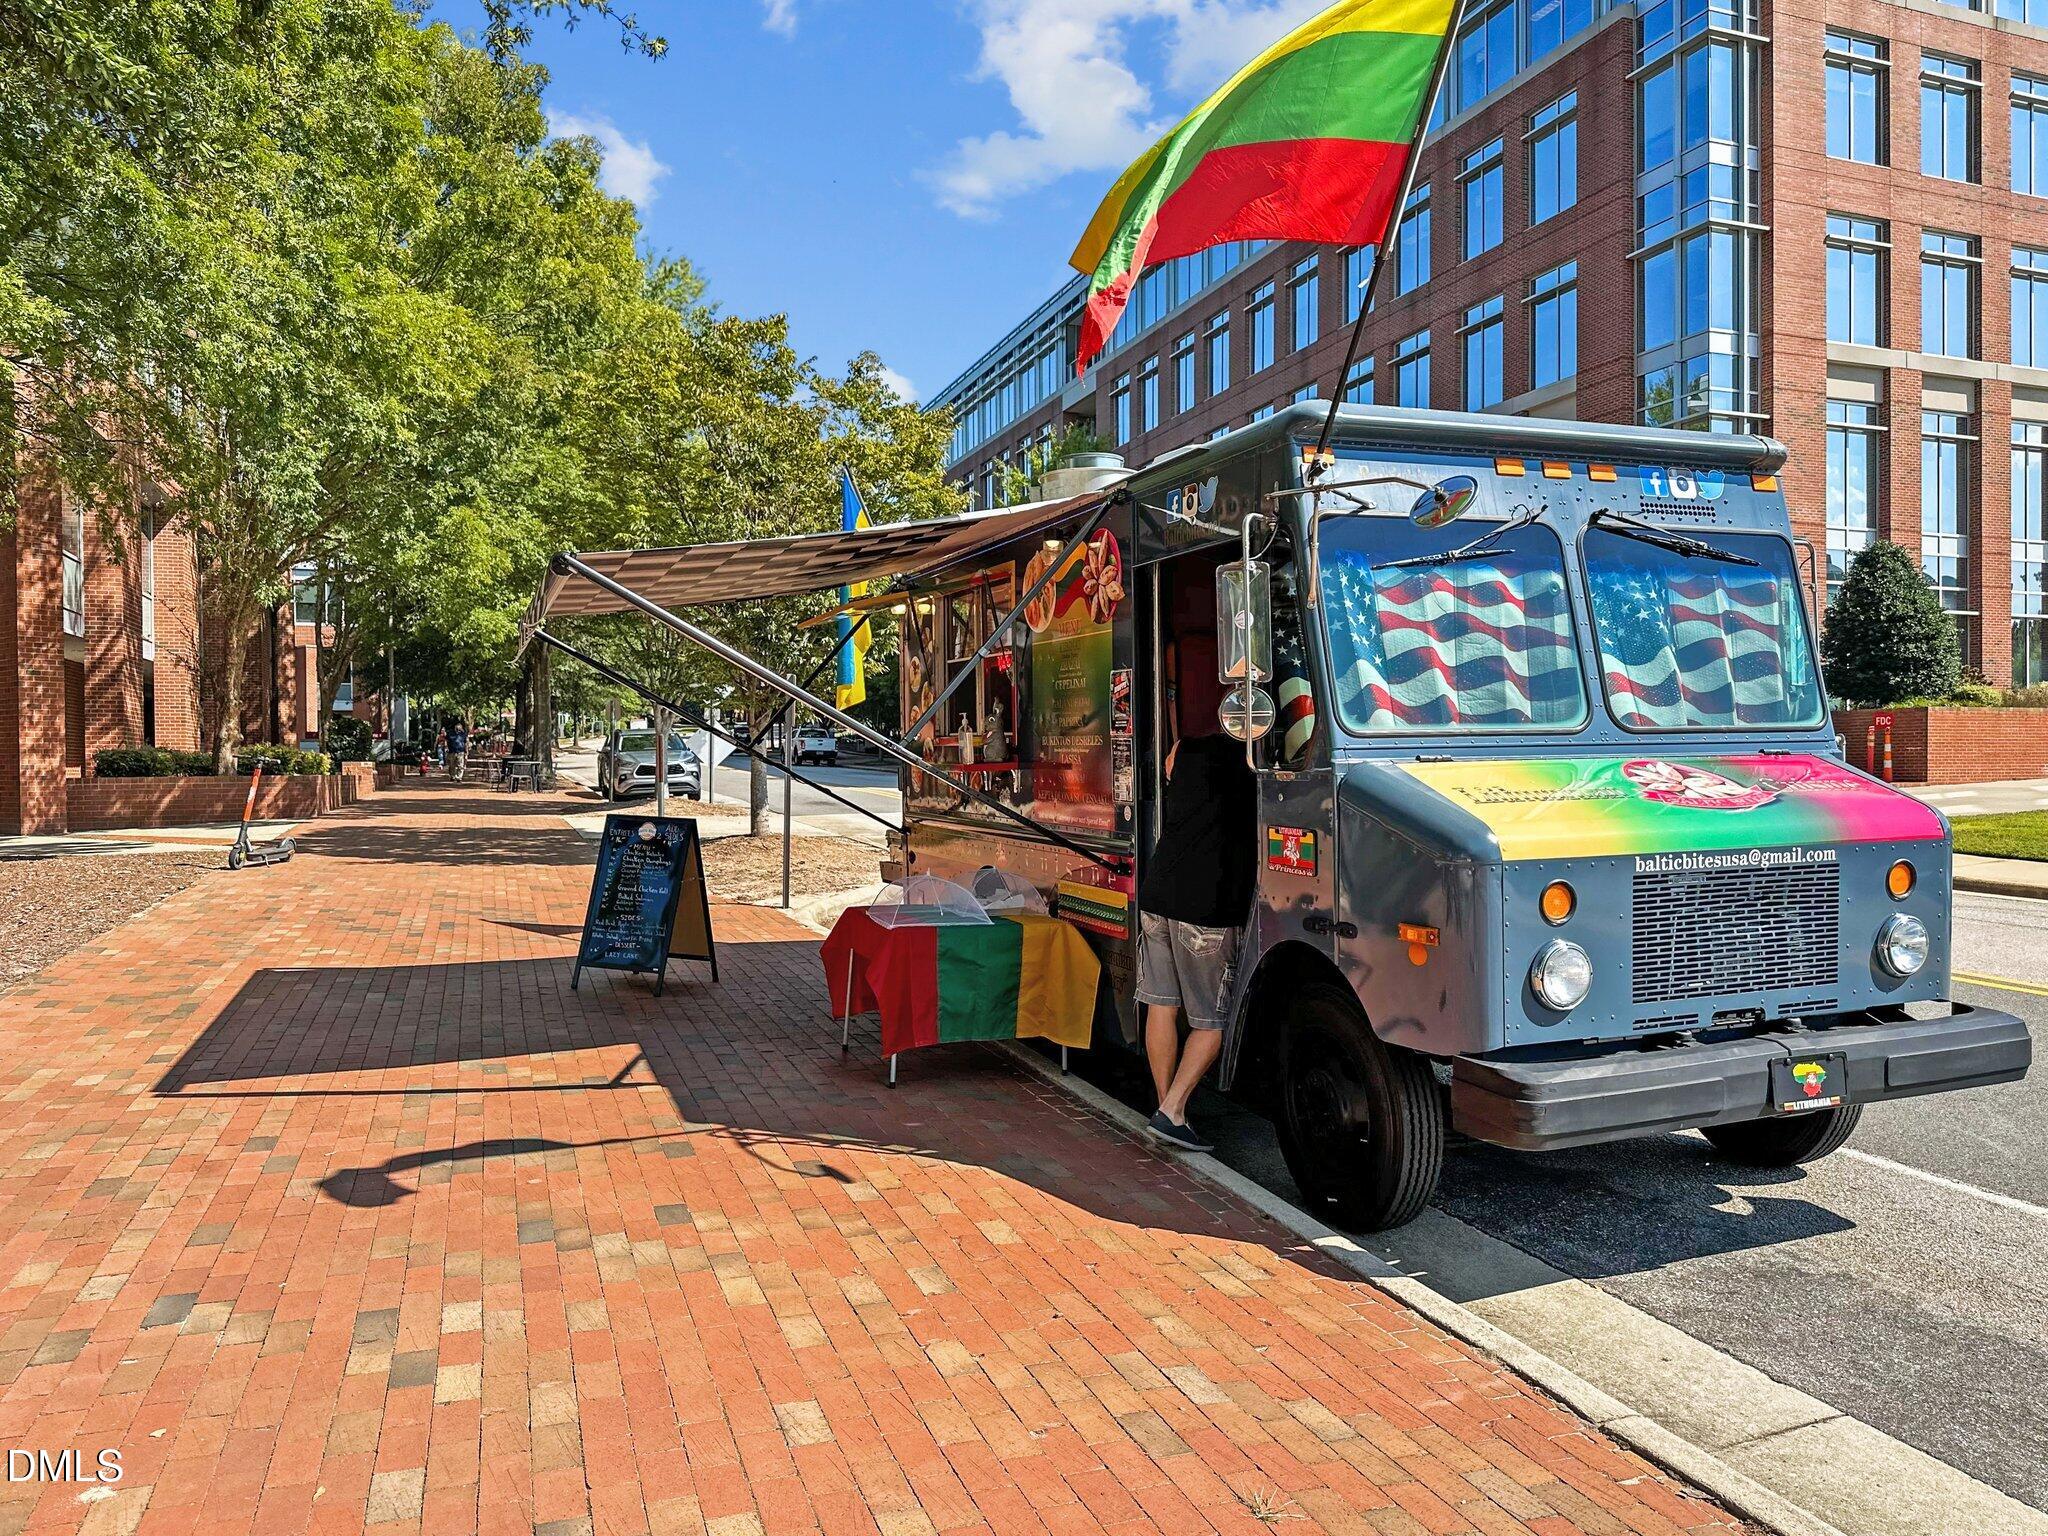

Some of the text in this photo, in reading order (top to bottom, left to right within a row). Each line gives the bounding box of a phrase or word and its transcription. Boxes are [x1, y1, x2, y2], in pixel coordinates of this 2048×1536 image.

[1059, 619, 1081, 636] MENU
[1875, 716, 1892, 726] FDC
[622, 855, 645, 863] Chicken
[1634, 847, 1837, 873] balticbitesusa@gmail.com
[617, 883, 637, 892] Ground
[638, 884, 658, 894] Chicken
[604, 951, 621, 959] LAZY
[1793, 1096, 1832, 1111] LITHUANIA
